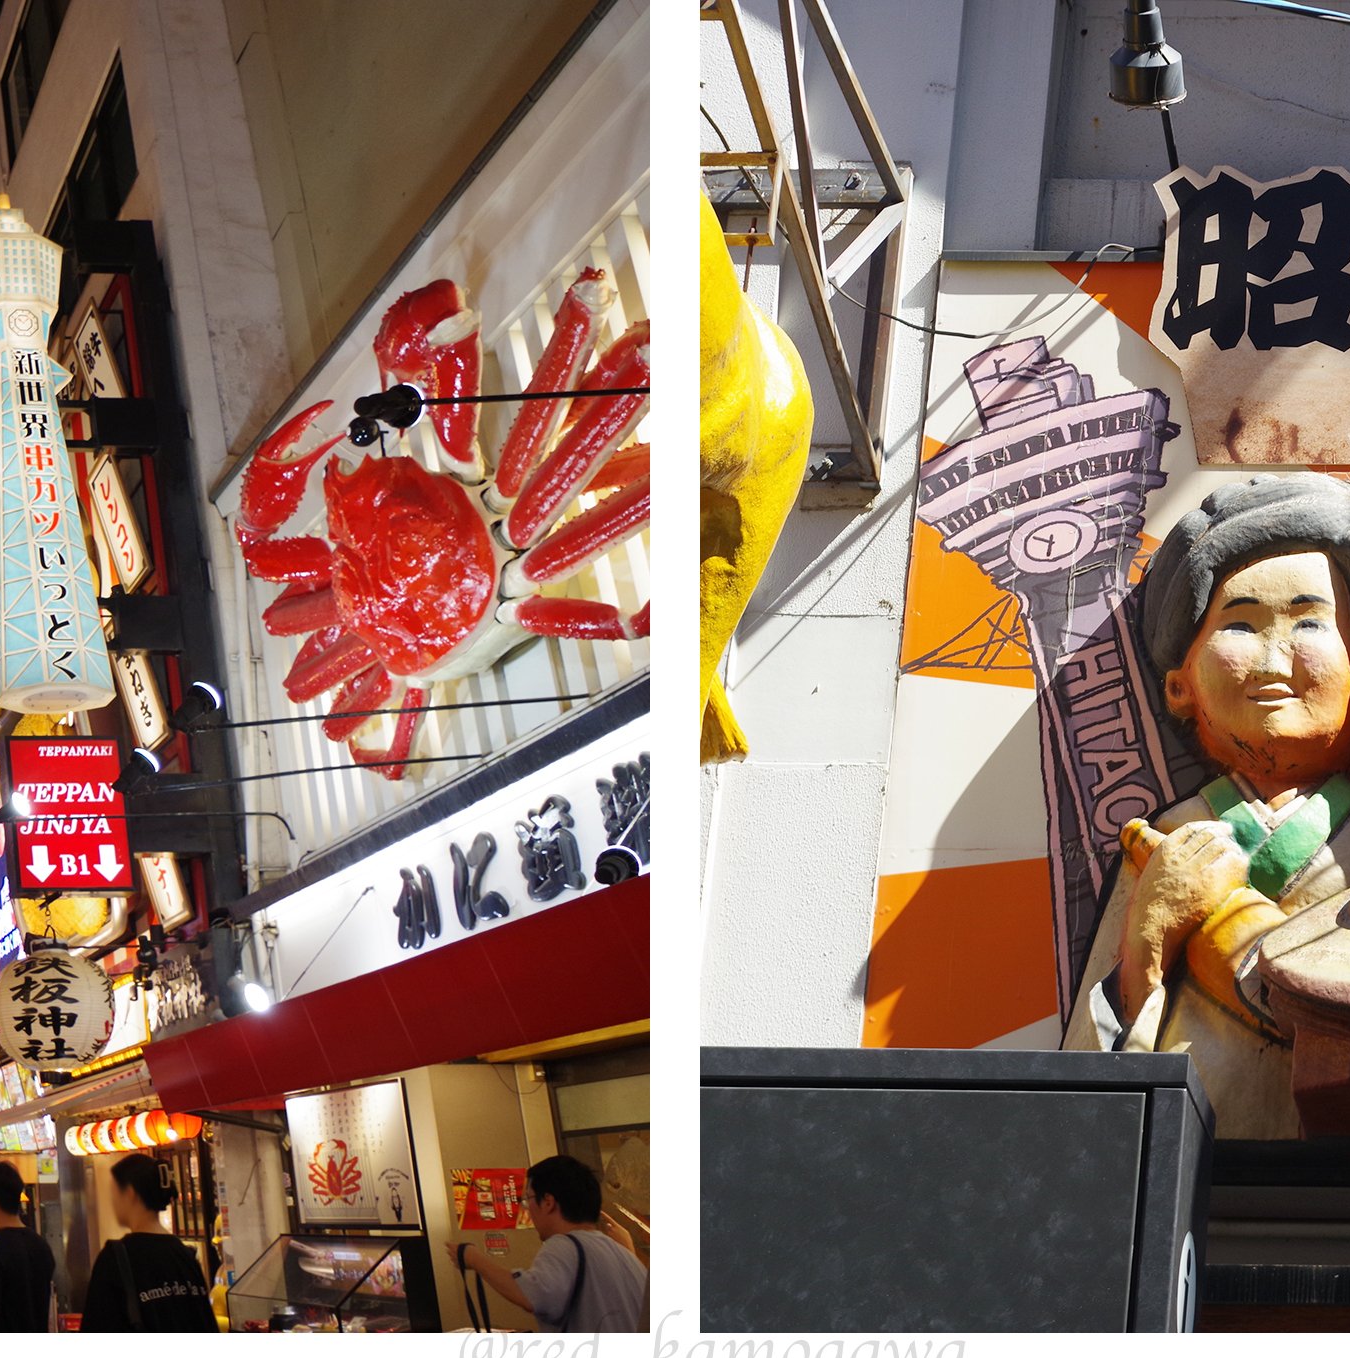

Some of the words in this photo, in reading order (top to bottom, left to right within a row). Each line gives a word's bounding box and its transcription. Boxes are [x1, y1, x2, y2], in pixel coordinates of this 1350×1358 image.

[12, 349, 77, 680] 新世界串カツいっとく
[38, 745, 113, 758] TEPPANYAKI
[1055, 640, 1159, 856] HITAC
[17, 782, 115, 804] TEPPAN
[20, 814, 112, 835] JINJYA
[61, 855, 90, 876] B1
[10, 956, 79, 1062] 鉄板神社
